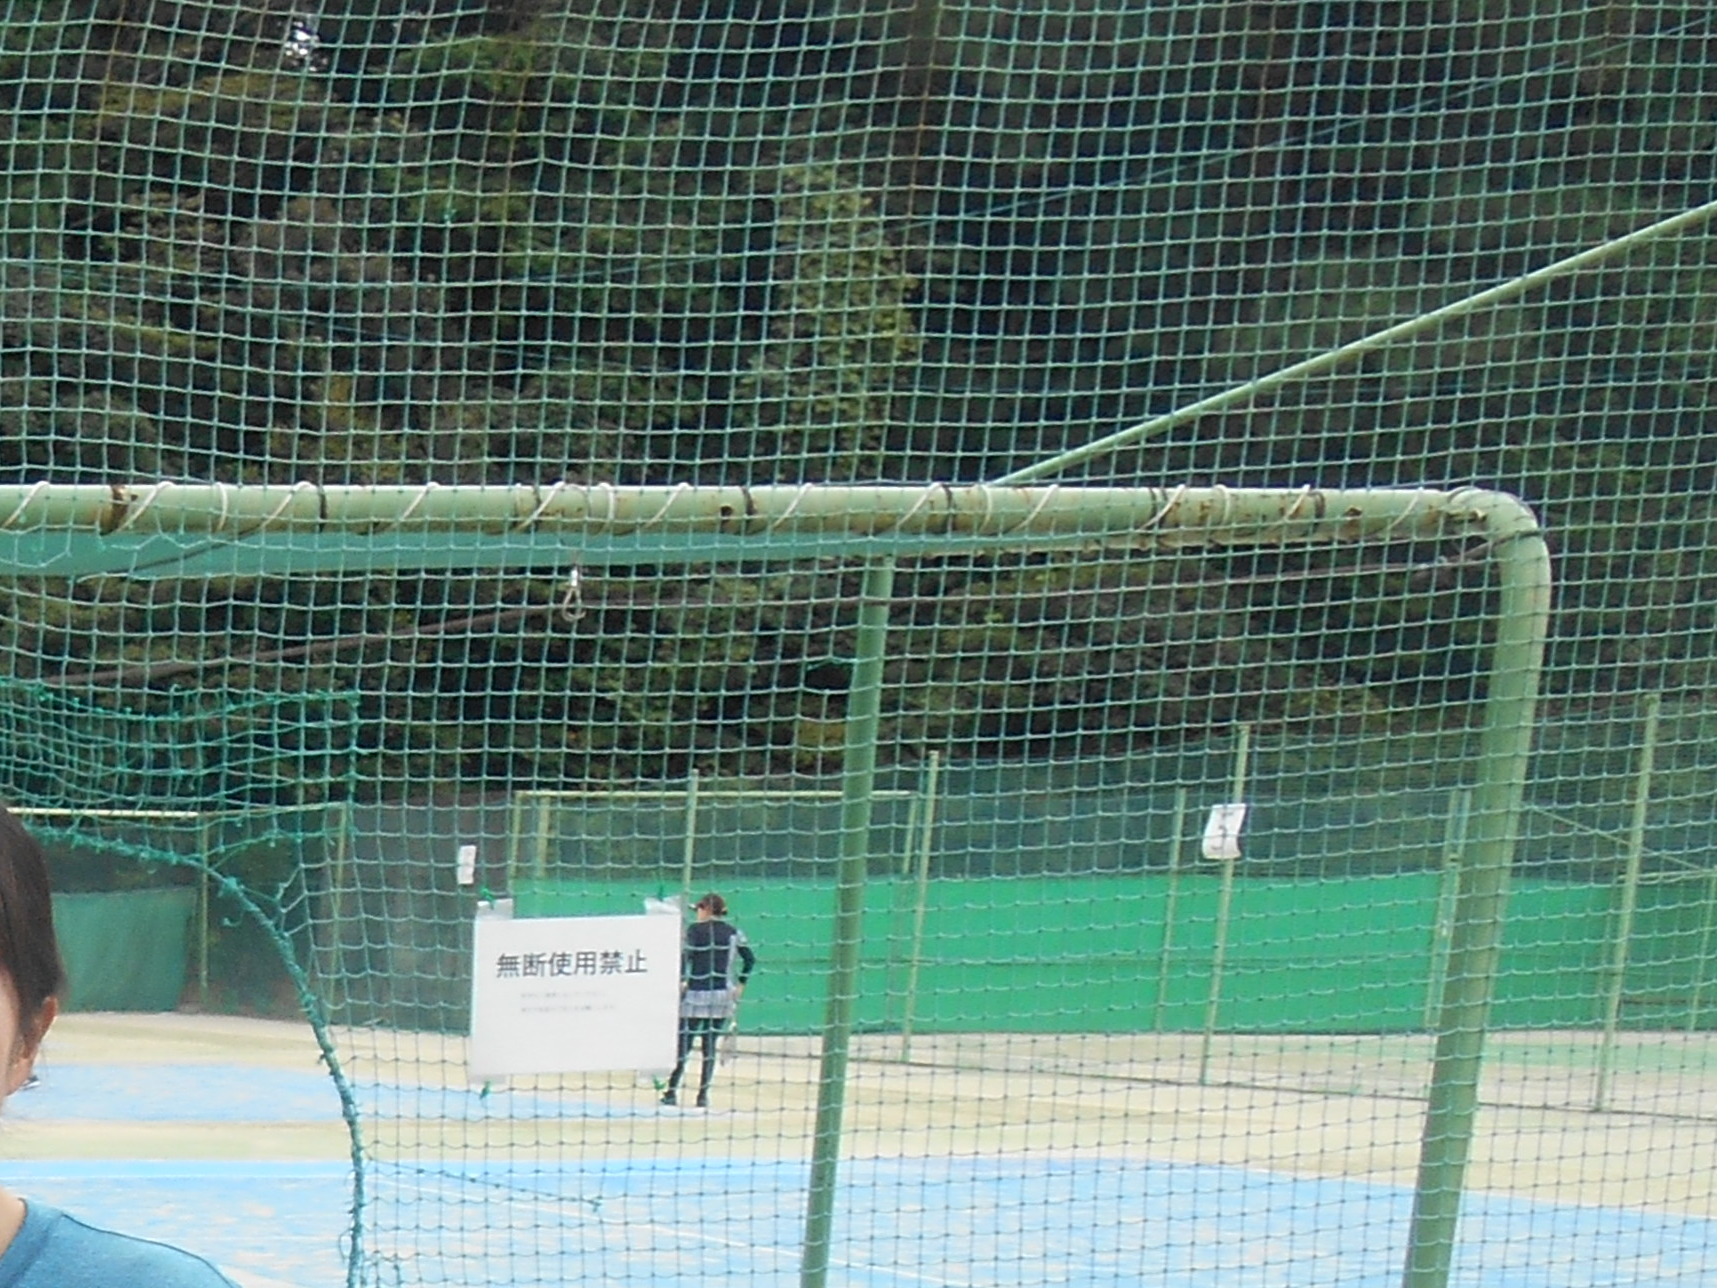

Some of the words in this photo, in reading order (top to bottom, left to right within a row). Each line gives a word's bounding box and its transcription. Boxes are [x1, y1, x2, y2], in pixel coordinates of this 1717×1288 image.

[496, 949, 648, 978] 無断使用禁止
